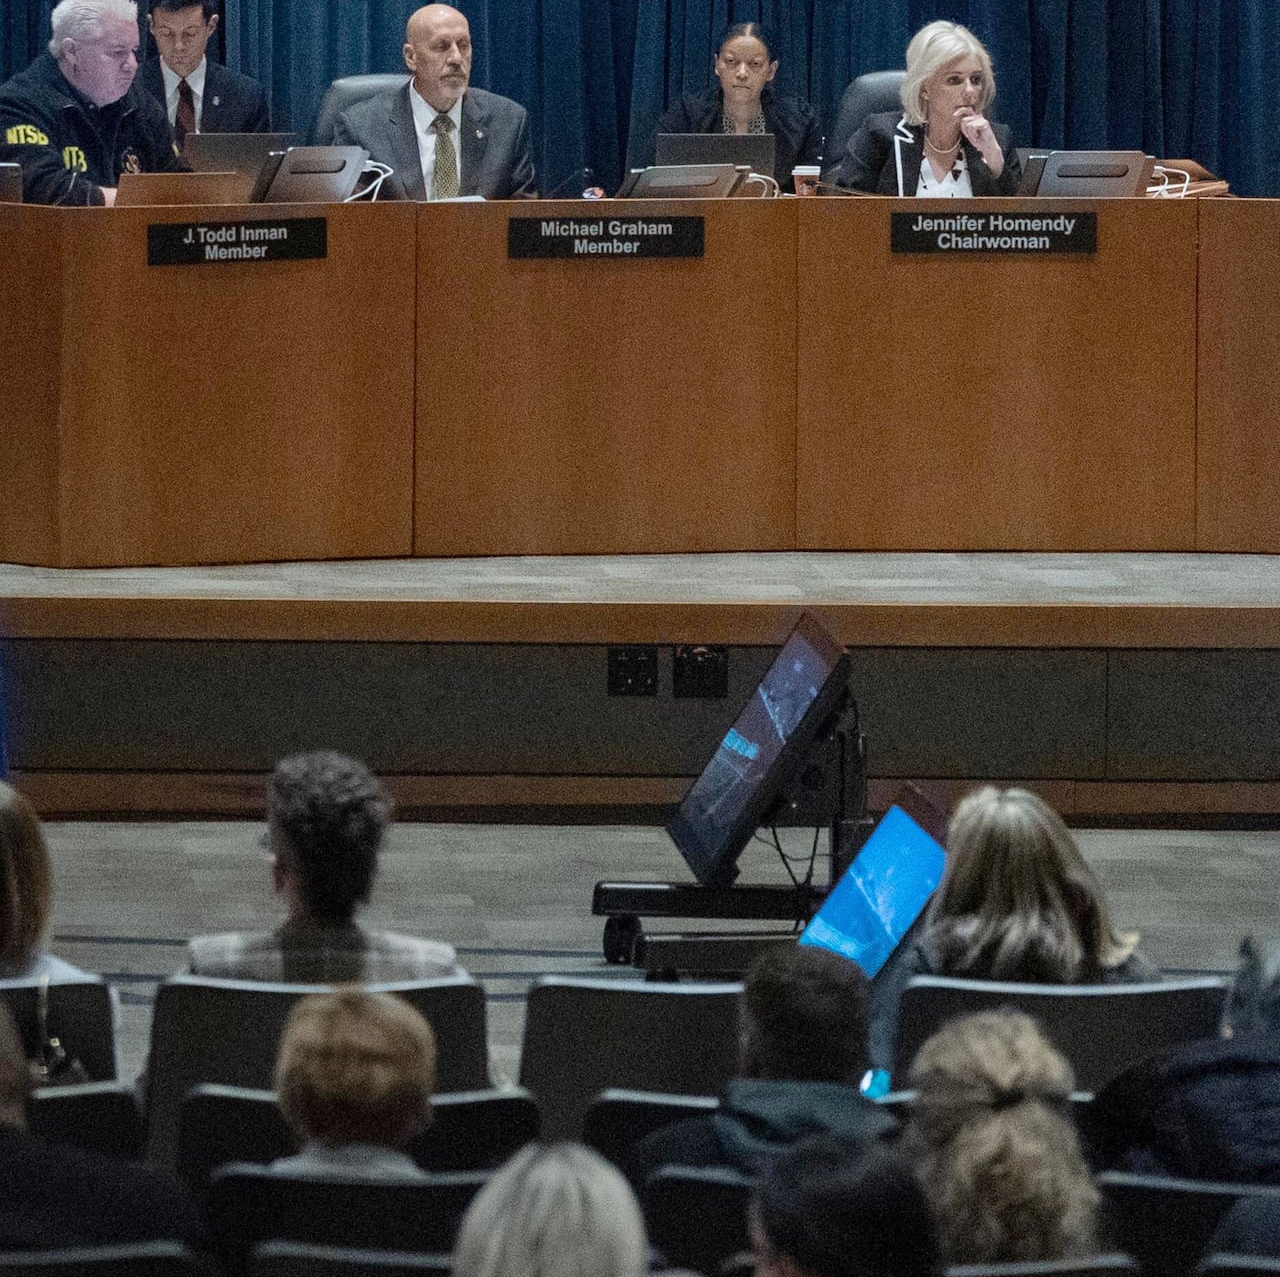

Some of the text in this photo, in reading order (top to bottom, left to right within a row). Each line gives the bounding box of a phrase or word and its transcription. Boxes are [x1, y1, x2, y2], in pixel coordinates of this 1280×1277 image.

[541, 221, 673, 237] Michael Graham
[912, 216, 1076, 235] Jennifer Homendy
[183, 227, 288, 244] J. Todd Inman
[937, 233, 1050, 249] Chairwoman
[205, 244, 268, 259] Member
[574, 239, 640, 254] Member
